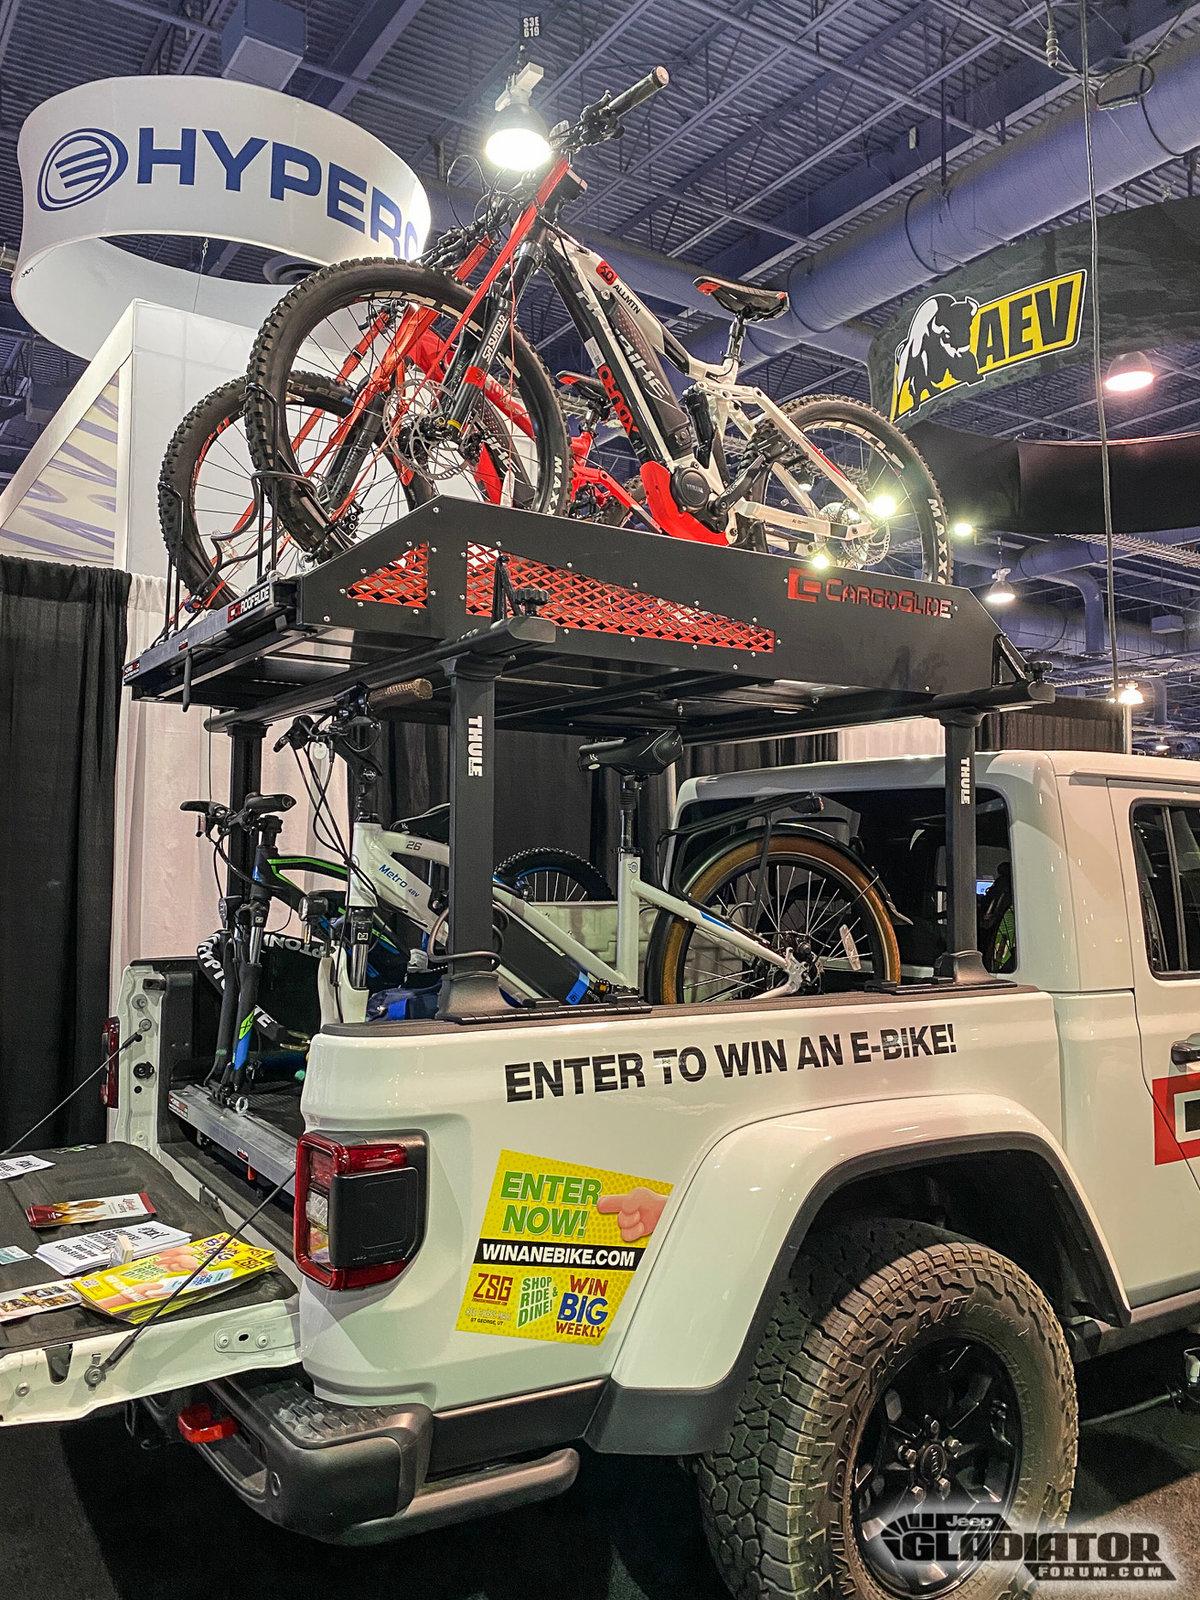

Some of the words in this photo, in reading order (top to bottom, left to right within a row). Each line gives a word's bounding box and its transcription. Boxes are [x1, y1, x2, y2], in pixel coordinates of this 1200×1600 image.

[523, 16, 540, 27] S3E
[523, 26, 540, 38] 619
[613, 284, 641, 314] ALLMTN
[976, 280, 1074, 368] AEV
[468, 716, 483, 777] THULE
[960, 757, 970, 805] THULE
[406, 840, 422, 851] 26
[379, 864, 408, 888] Metro
[504, 1051, 646, 1103] ENTER
[653, 1046, 707, 1084] TO
[714, 1038, 788, 1079] WIN
[797, 1033, 844, 1071] AN
[851, 1023, 958, 1064] E-BIKE!
[500, 1171, 603, 1206] ENTER
[501, 1204, 591, 1238] NOW!
[482, 1243, 635, 1267] WINANEBIKE.COM
[473, 1272, 513, 1302] ZSG
[520, 1288, 550, 1308] RIDE
[522, 1276, 552, 1292] SHOP
[570, 1274, 608, 1297] WIN
[518, 1301, 553, 1329] DINE!
[557, 1292, 608, 1326] BIG
[555, 1321, 606, 1339] WEEKLY
